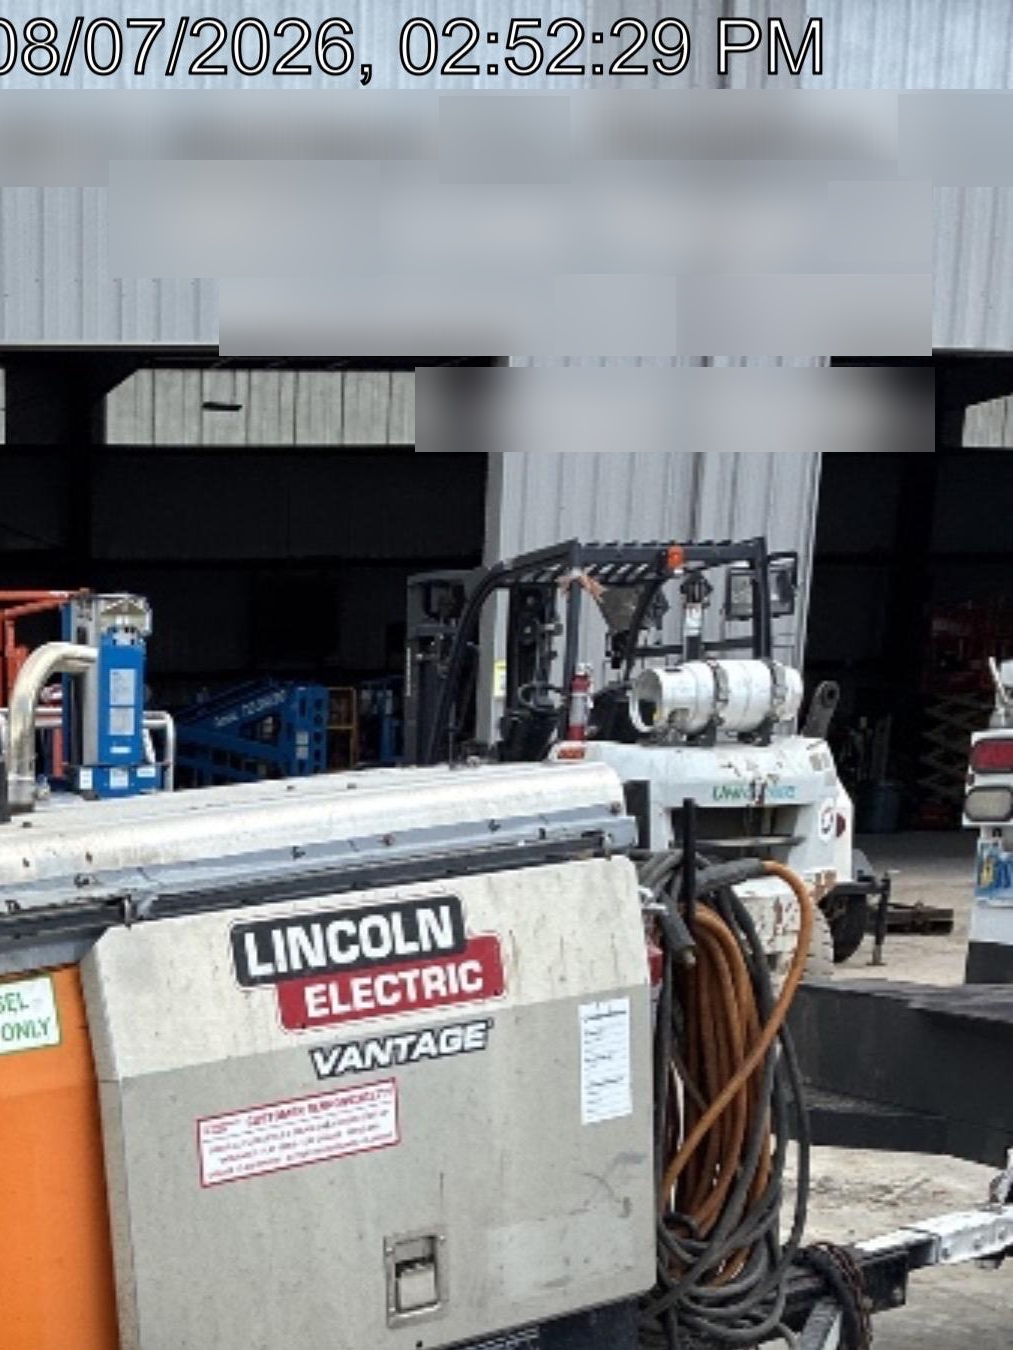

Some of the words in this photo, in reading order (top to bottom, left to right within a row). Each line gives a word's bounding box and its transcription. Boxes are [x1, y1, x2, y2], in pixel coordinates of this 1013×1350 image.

[244, 905, 454, 977] LINCOLN
[304, 960, 484, 1018] ELECTRIC
[1, 1017, 51, 1042] ONLY
[310, 1020, 490, 1079] VANTAGE
